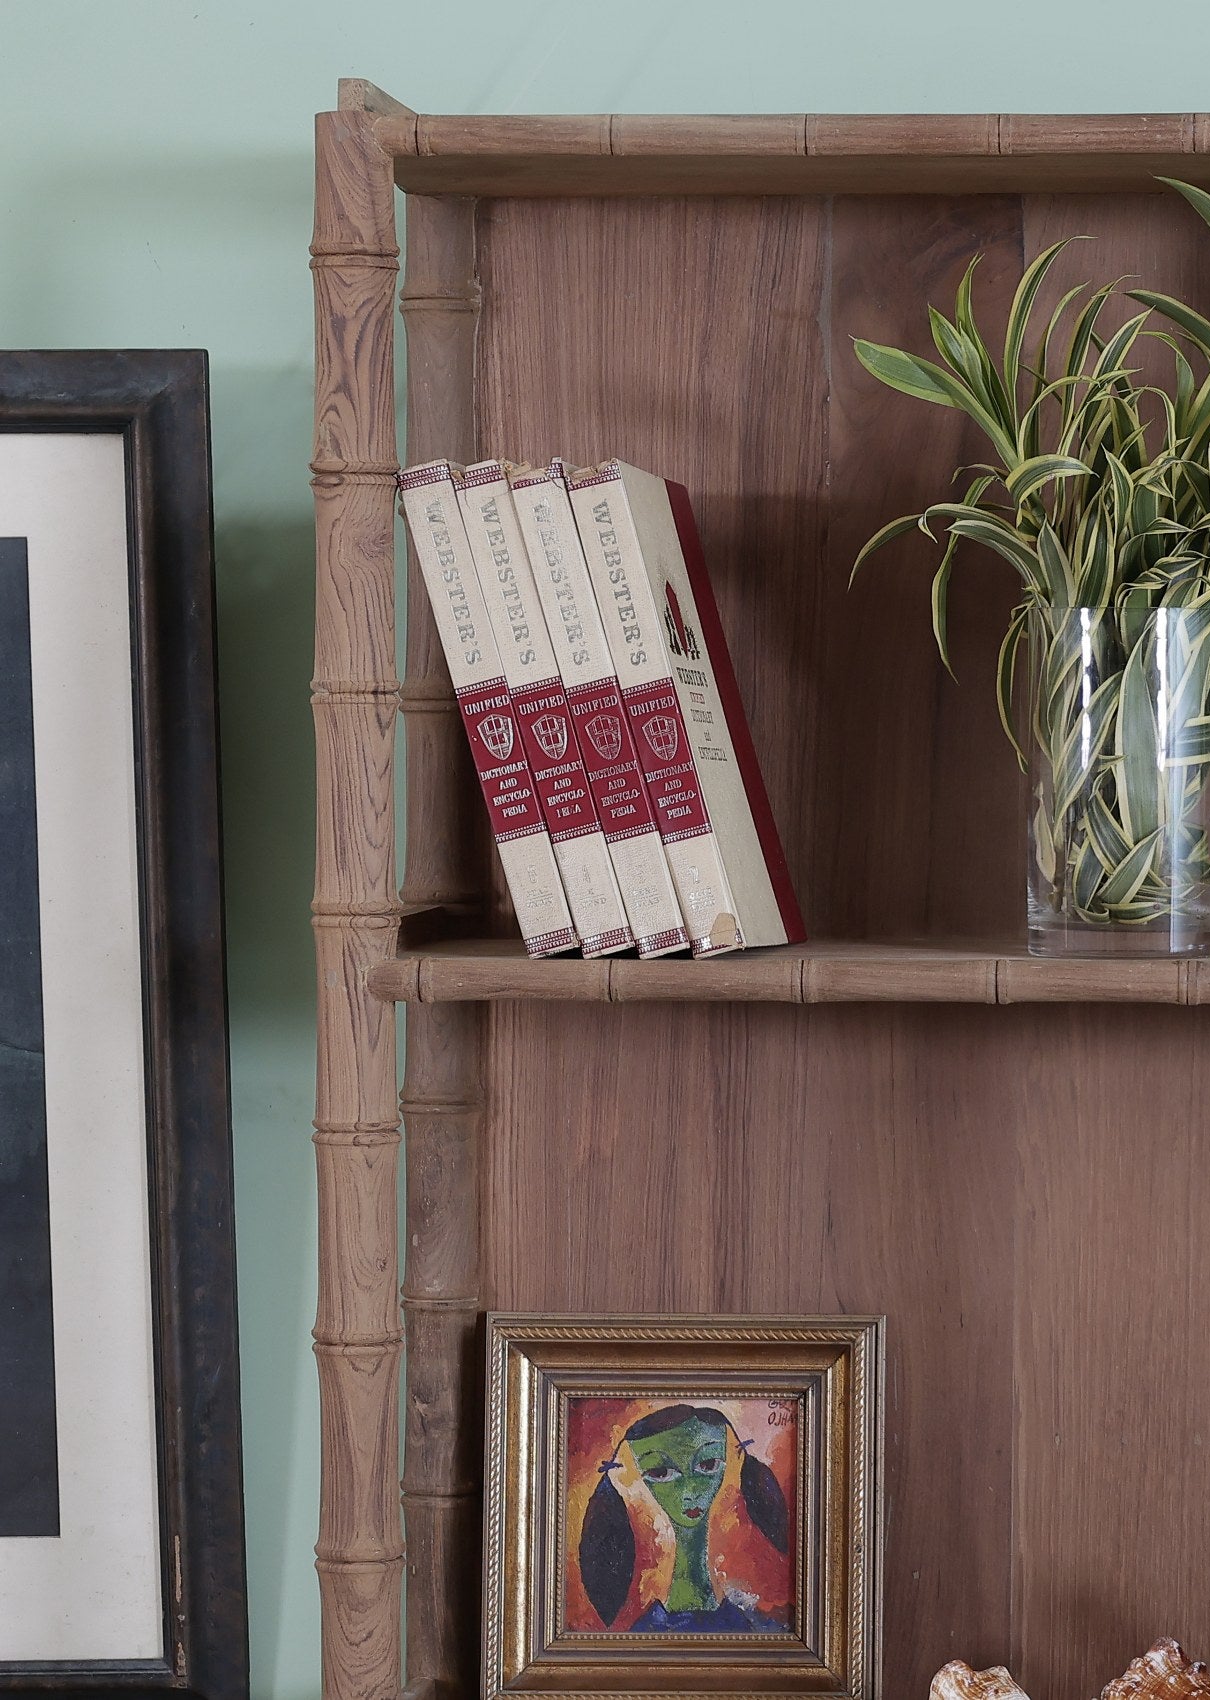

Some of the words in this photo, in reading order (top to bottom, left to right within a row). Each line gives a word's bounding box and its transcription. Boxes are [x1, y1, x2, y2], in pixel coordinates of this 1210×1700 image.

[424, 498, 483, 666] WEBSTER'S
[479, 498, 537, 666] WEBSTER'S
[532, 499, 591, 666] WEBSTER'S
[592, 498, 648, 667] WEBSTER'S
[464, 694, 510, 717] UNIFIED
[518, 693, 566, 716] UNIFIED
[571, 695, 618, 717] UNIFIED
[629, 695, 676, 718] UNIFIED
[479, 760, 529, 782] DICTIONARY
[534, 760, 583, 782] DICTIONARY
[587, 760, 638, 783] DICTIONARY
[644, 761, 695, 784] DICTIONARY
[499, 777, 518, 791] AND
[553, 777, 572, 791] AND
[607, 778, 626, 791] AND
[664, 779, 682, 792] AND
[502, 803, 528, 819] PEDIA
[610, 804, 636, 820] PEDIA
[666, 805, 693, 820] PEDIA
